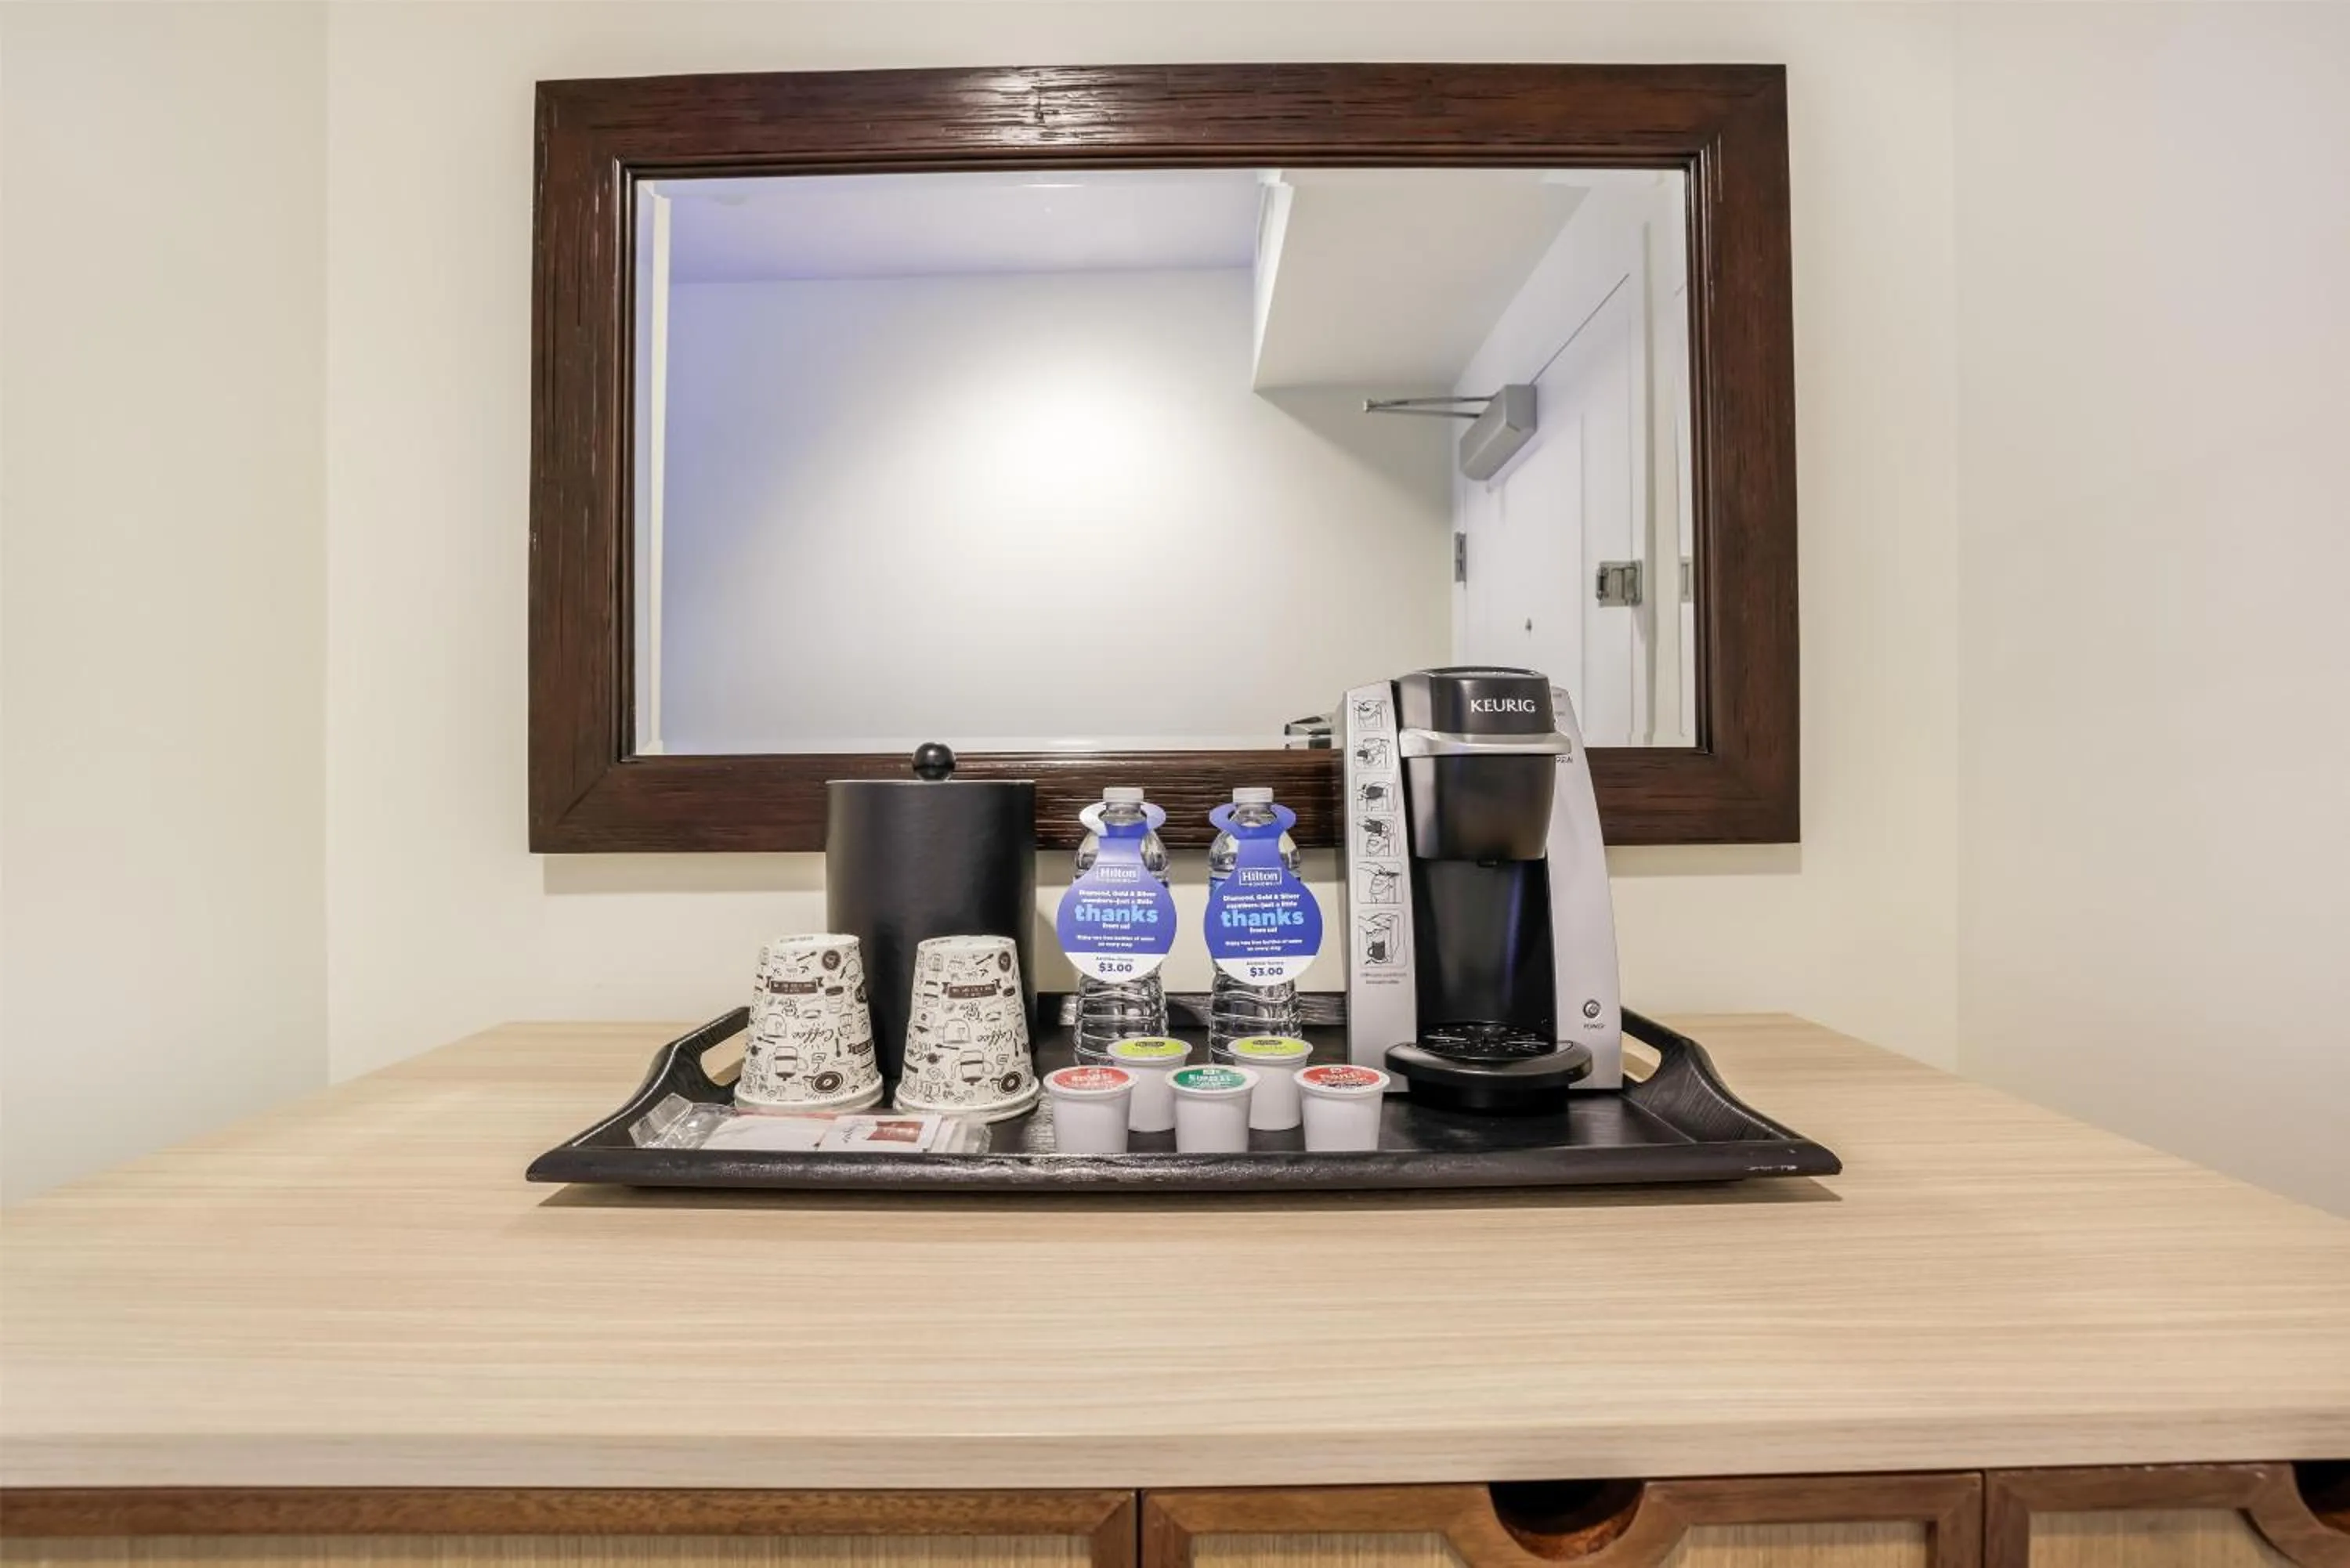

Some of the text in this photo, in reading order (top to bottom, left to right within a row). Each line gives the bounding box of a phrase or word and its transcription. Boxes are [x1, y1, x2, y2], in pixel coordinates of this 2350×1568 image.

[1470, 699, 1536, 713] KEURIG
[1100, 867, 1137, 879] Hilton
[1242, 871, 1278, 882] Hilton
[1074, 904, 1159, 923] thanks
[1220, 908, 1305, 927] thanks
[1098, 963, 1133, 972] $3.00
[1249, 967, 1284, 977] $3.00
[790, 1028, 834, 1044] Coffee
[977, 1028, 1013, 1046] Coffee
